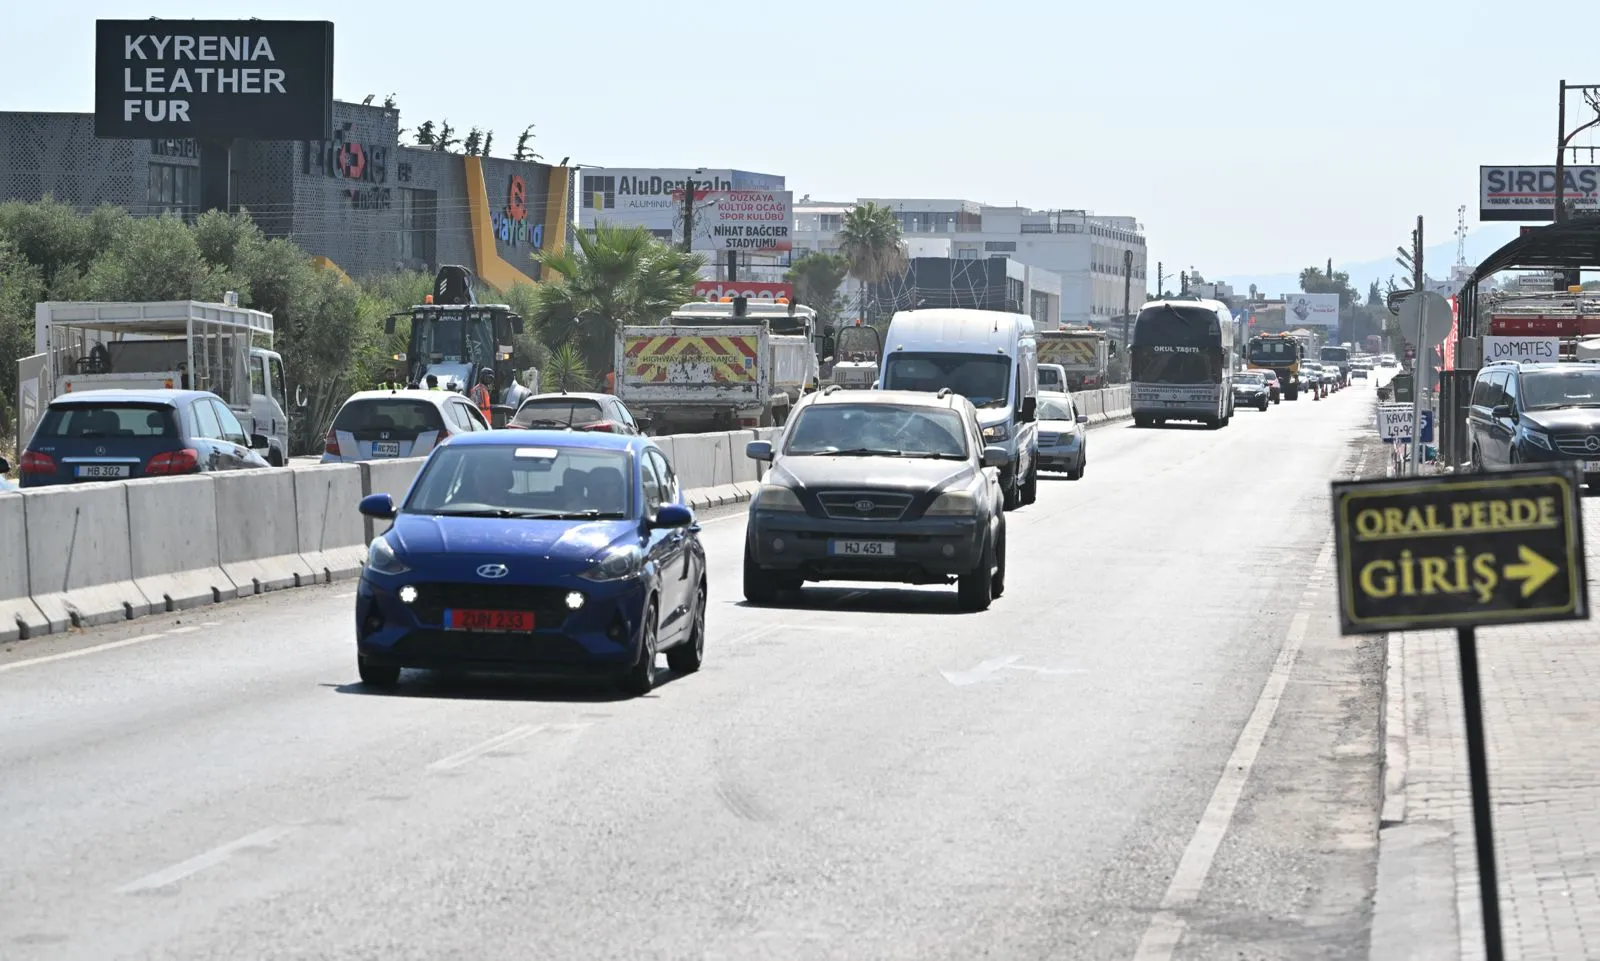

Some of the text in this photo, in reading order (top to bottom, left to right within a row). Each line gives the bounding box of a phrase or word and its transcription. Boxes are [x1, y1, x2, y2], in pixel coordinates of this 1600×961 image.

[124, 34, 275, 61] KYRENIA
[124, 67, 287, 94] LEATHER
[124, 99, 191, 122] FUR
[1487, 169, 1598, 197] SIRDAŞ
[719, 212, 745, 221] SPOR
[714, 223, 745, 236] NİHAT
[725, 238, 777, 249] STADYUMU
[1154, 345, 1175, 353] OKUL
[642, 355, 679, 363] HIGHWAY
[87, 466, 120, 476] HB 302
[1355, 496, 1558, 538] ORAL PERDE
[844, 542, 883, 554] HJ 451
[1359, 545, 1498, 603] GİRİŞ
